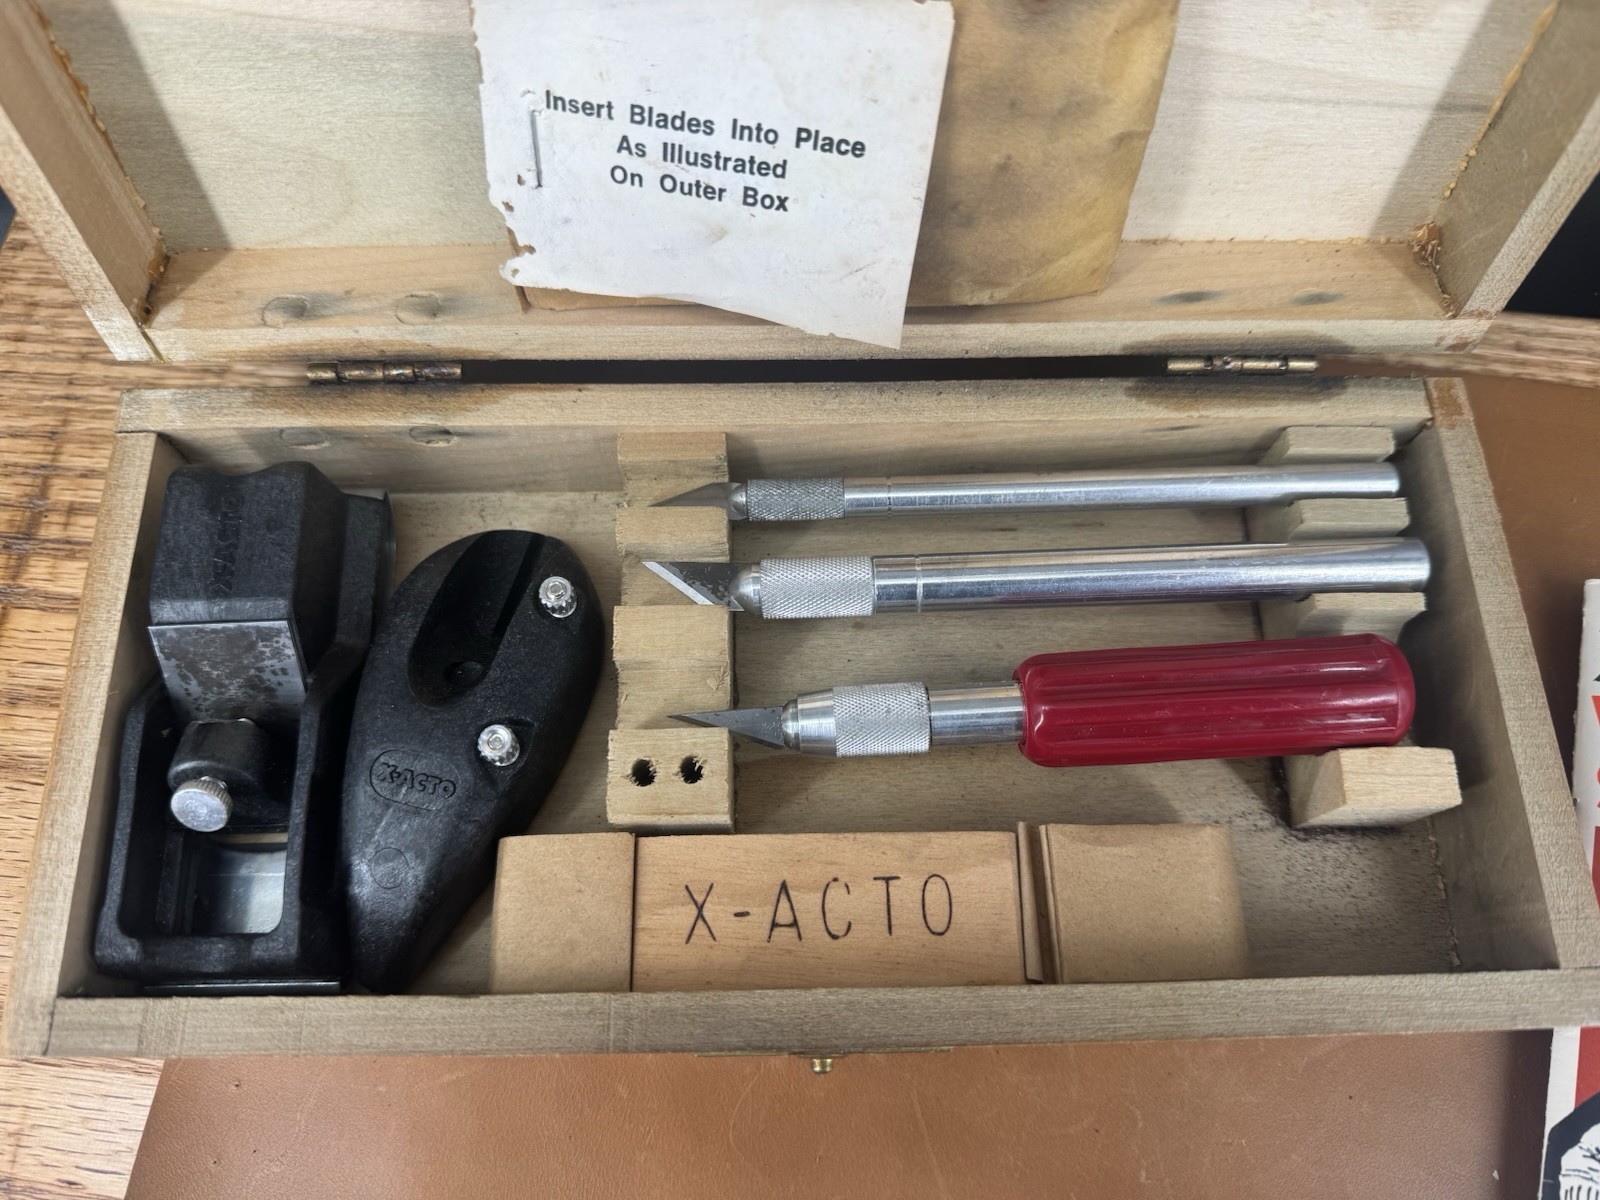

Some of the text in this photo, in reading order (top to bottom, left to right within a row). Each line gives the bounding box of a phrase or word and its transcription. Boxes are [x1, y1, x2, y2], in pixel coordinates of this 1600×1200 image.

[544, 89, 867, 159] Insert Blades Into Place
[616, 135, 788, 180] As Illustrated
[610, 165, 790, 213] On Outer Box
[376, 761, 457, 799] X-ACTO
[684, 873, 953, 944] X-ACTO
